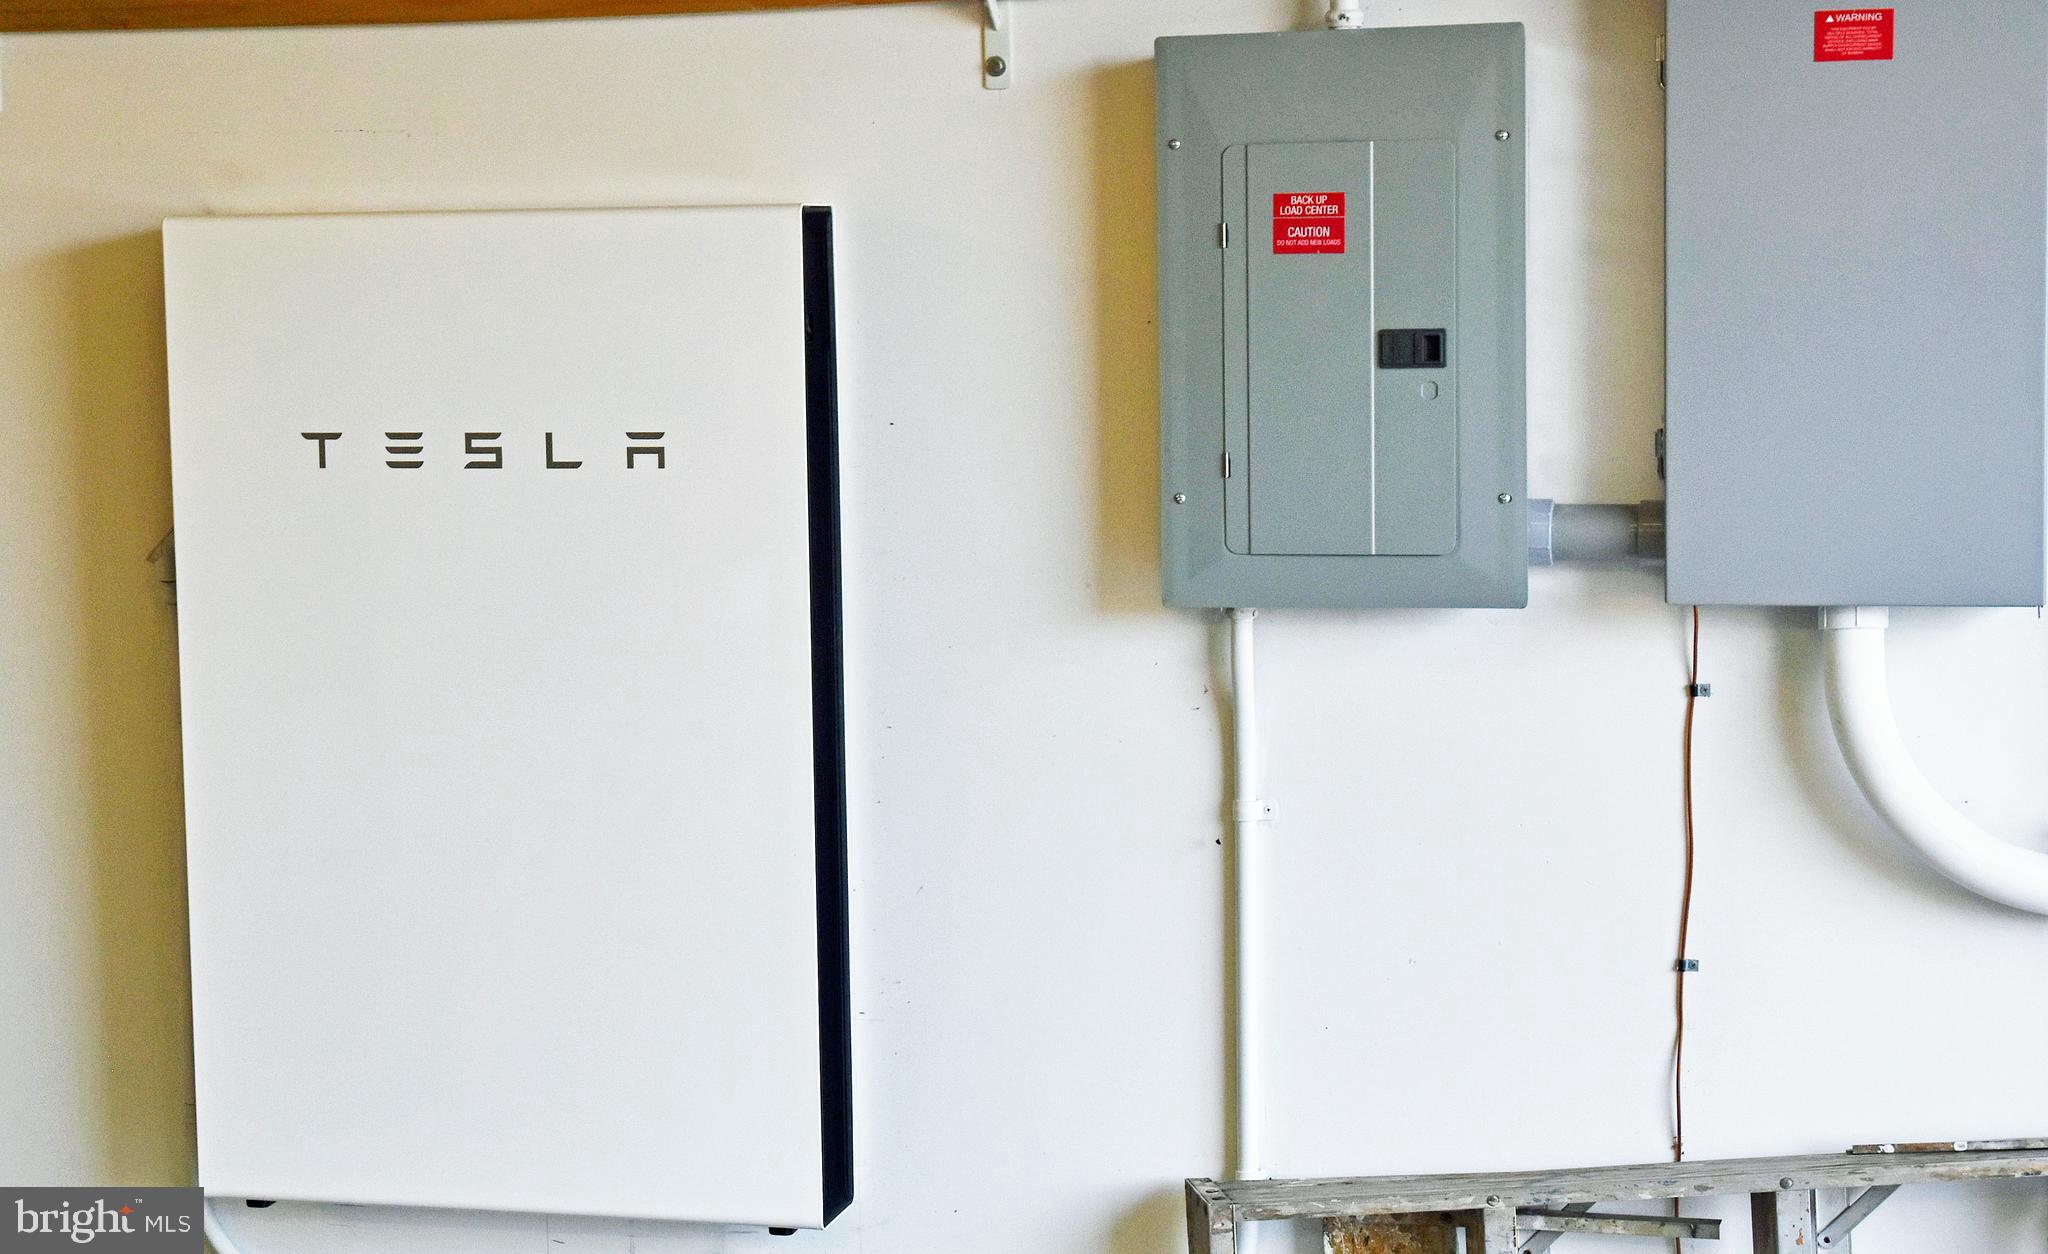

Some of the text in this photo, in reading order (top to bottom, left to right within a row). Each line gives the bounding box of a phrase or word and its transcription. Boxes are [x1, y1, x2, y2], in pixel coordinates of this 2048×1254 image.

[1836, 12, 1883, 22] WARNING
[1291, 195, 1328, 205] BACK UP
[1280, 205, 1339, 215] LOAD CENTER
[1288, 226, 1330, 237] CAUTION
[300, 431, 666, 470] TESLA
